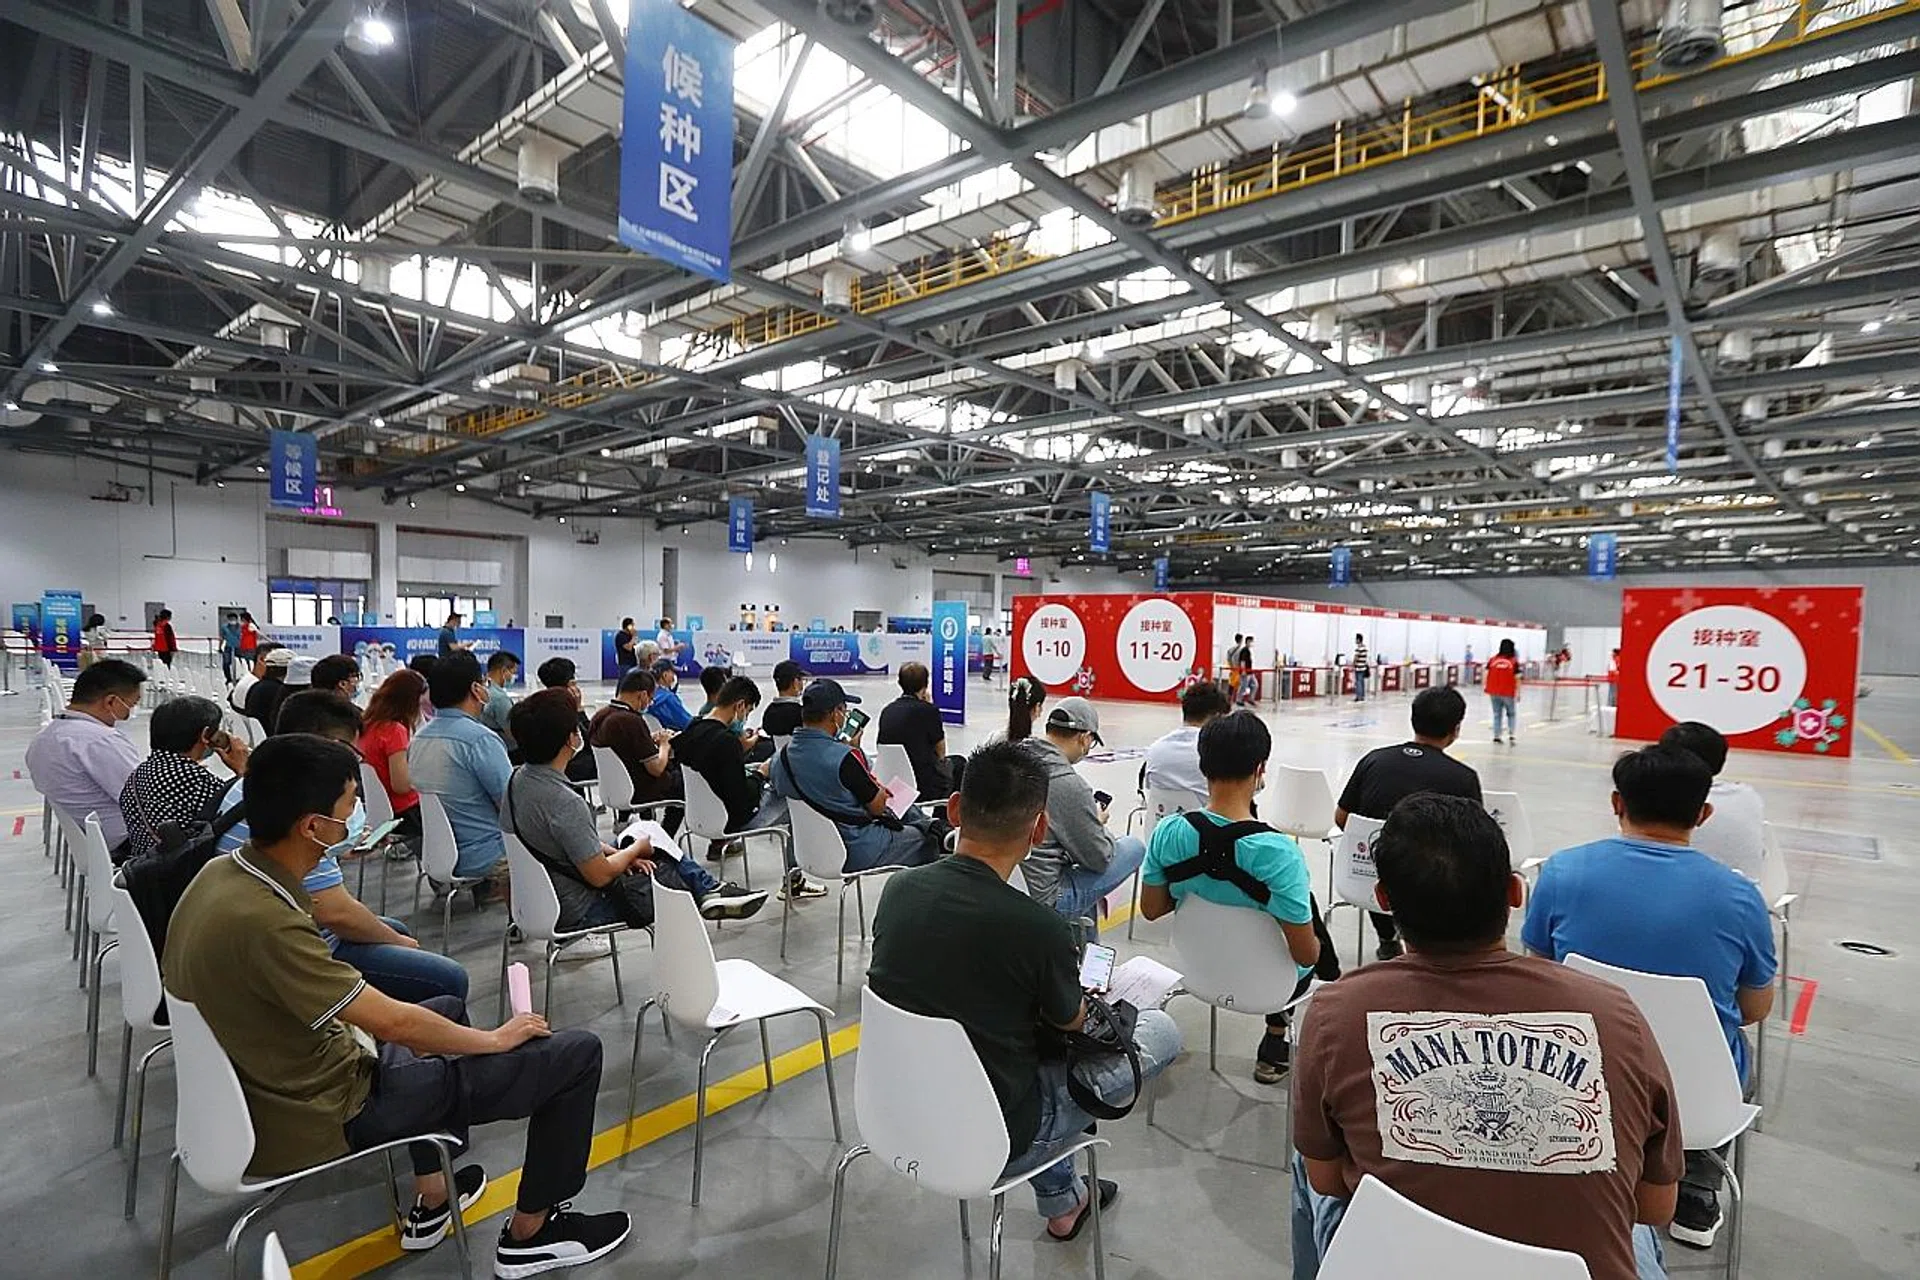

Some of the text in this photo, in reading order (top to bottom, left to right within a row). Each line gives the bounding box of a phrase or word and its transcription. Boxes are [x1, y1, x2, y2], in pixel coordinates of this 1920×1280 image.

[659, 44, 703, 221] 候种区
[1040, 616, 1068, 629] 接种室
[1140, 619, 1173, 633] 接种室
[1693, 627, 1762, 648] 接种室
[1036, 640, 1071, 657] 1-10
[1130, 641, 1183, 661] 11-20
[1667, 662, 1781, 693] 21-30
[1385, 1030, 1589, 1090] MANA TOTEM
